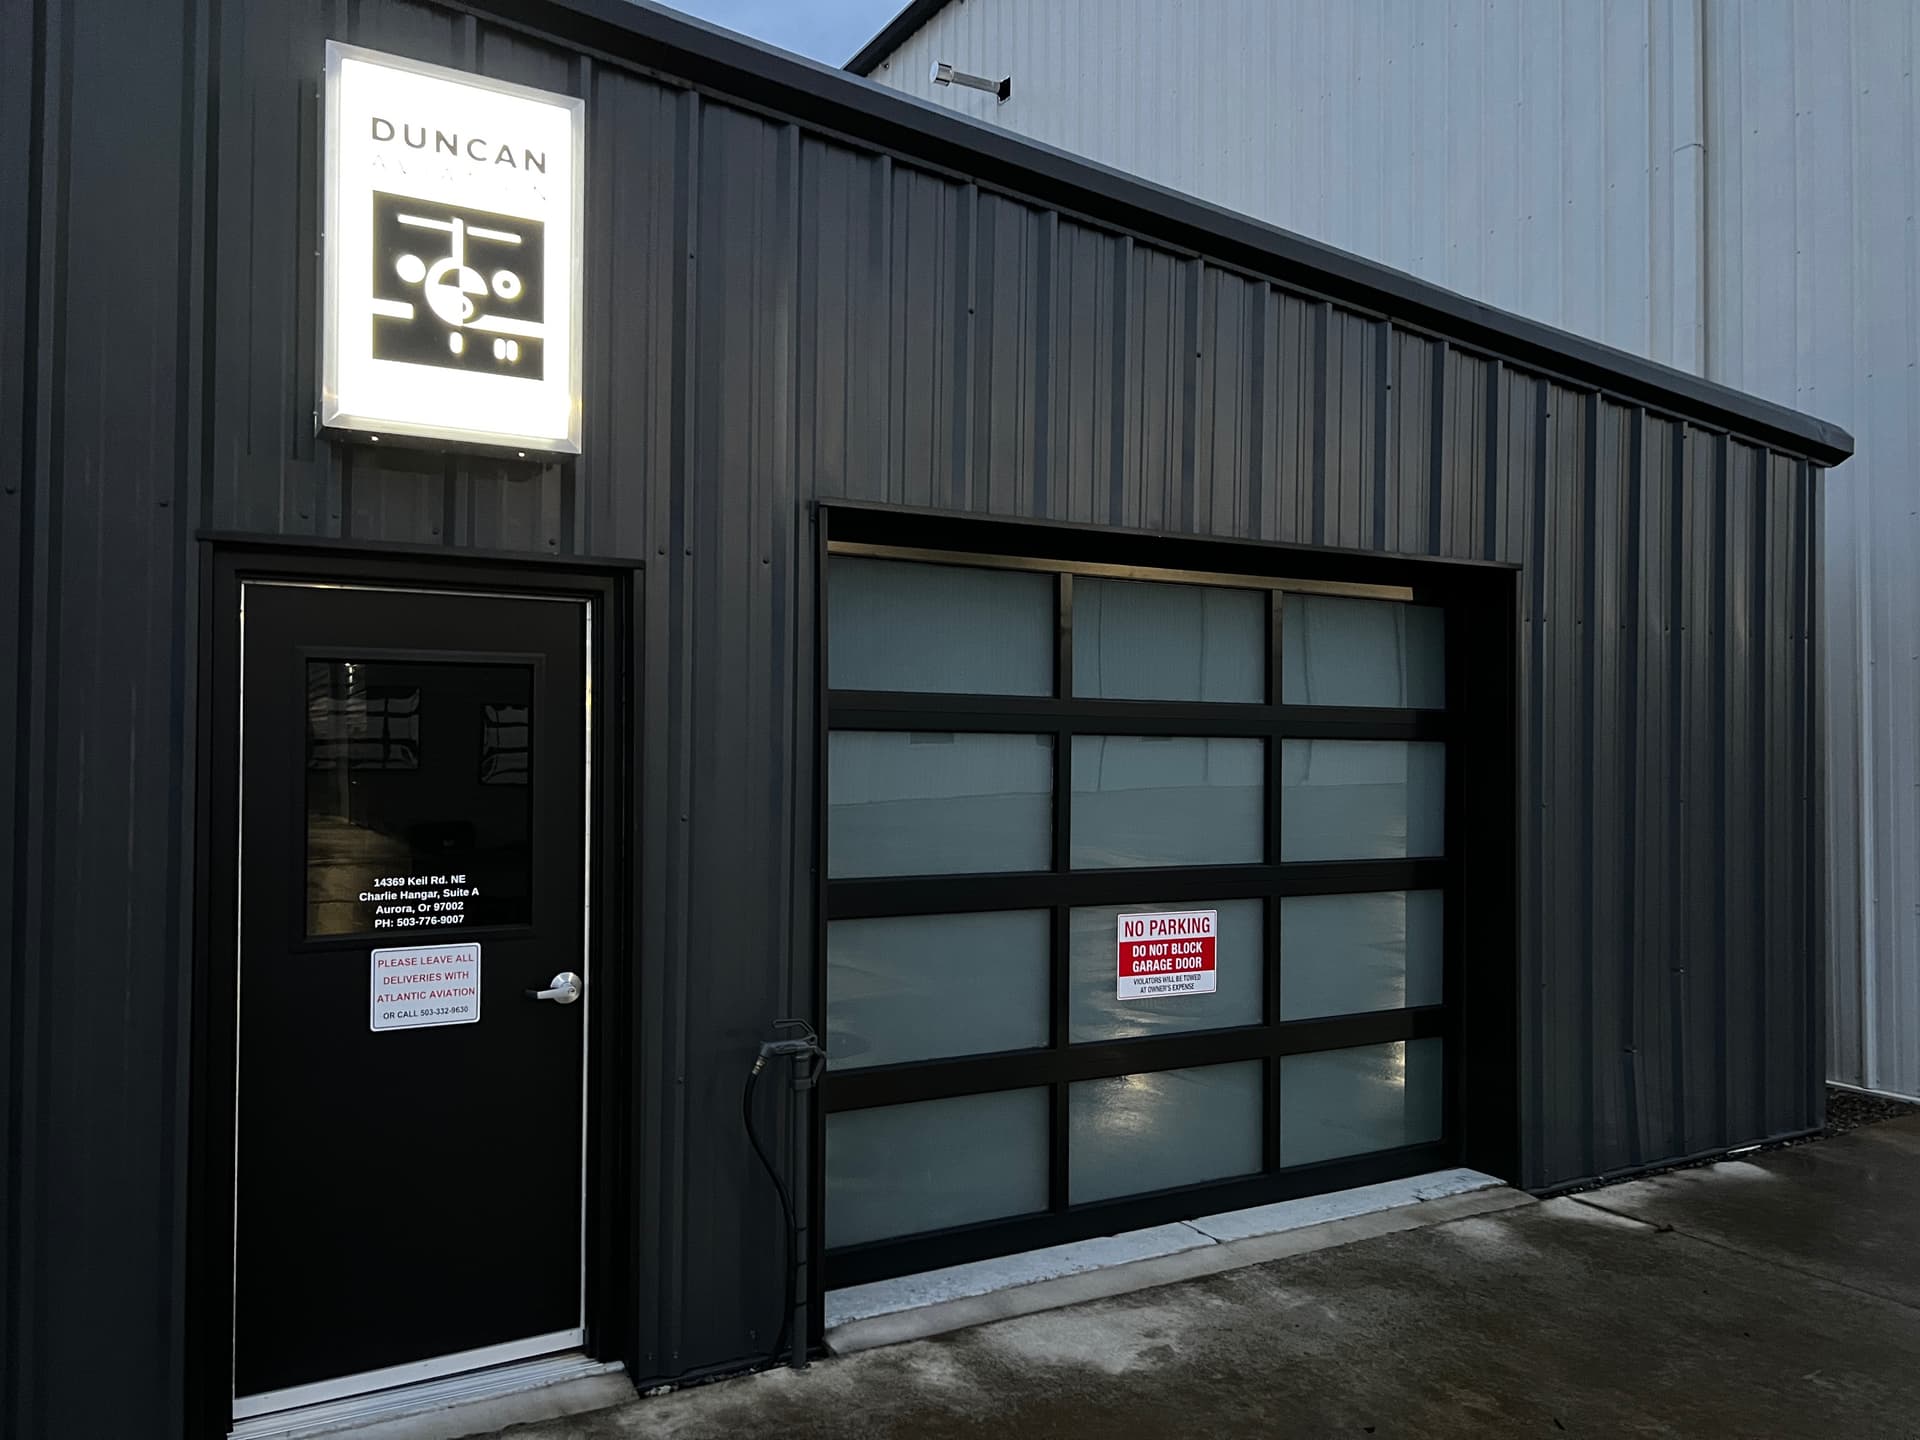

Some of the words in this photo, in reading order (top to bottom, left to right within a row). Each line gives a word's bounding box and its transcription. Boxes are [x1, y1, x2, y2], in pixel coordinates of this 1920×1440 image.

[372, 116, 546, 174] DUNCAN
[374, 877, 405, 887] 14369
[408, 876, 428, 886] Keil
[431, 875, 448, 885] Rd.
[451, 875, 466, 884] NE
[359, 891, 397, 901] Charlie
[400, 890, 440, 900] Hangar,
[443, 888, 469, 898] Suite
[472, 887, 479, 896] A
[376, 904, 415, 914] Aurora,
[418, 903, 431, 912] Or
[434, 902, 464, 911] 97002
[374, 919, 394, 928] PH:
[397, 914, 464, 927] 503-776-9007
[1124, 920, 1144, 937] NO
[1149, 917, 1211, 936] PARKING
[1132, 945, 1146, 957] DO
[1149, 943, 1168, 956] NOT
[1171, 941, 1202, 955] BLOCK
[378, 957, 417, 968] PLEASE
[421, 955, 452, 965] LEAVE
[455, 953, 474, 963] ALL
[1132, 959, 1173, 973] GARAGE
[1175, 957, 1202, 970] DOOR
[383, 972, 442, 985] DELIVERIES
[445, 971, 469, 981] WITH
[1133, 976, 1162, 985] VIOLATORS
[1162, 975, 1175, 983] WILL
[1184, 974, 1201, 982] TOWED
[377, 991, 426, 1003] ATLANTIC
[429, 987, 475, 999] AVIATION
[1147, 984, 1171, 993] OWNER'S
[1172, 983, 1195, 991] EXPENSE
[383, 1011, 395, 1020] OR
[397, 1010, 418, 1018] CALL
[420, 1006, 469, 1017] 503-332-9630
